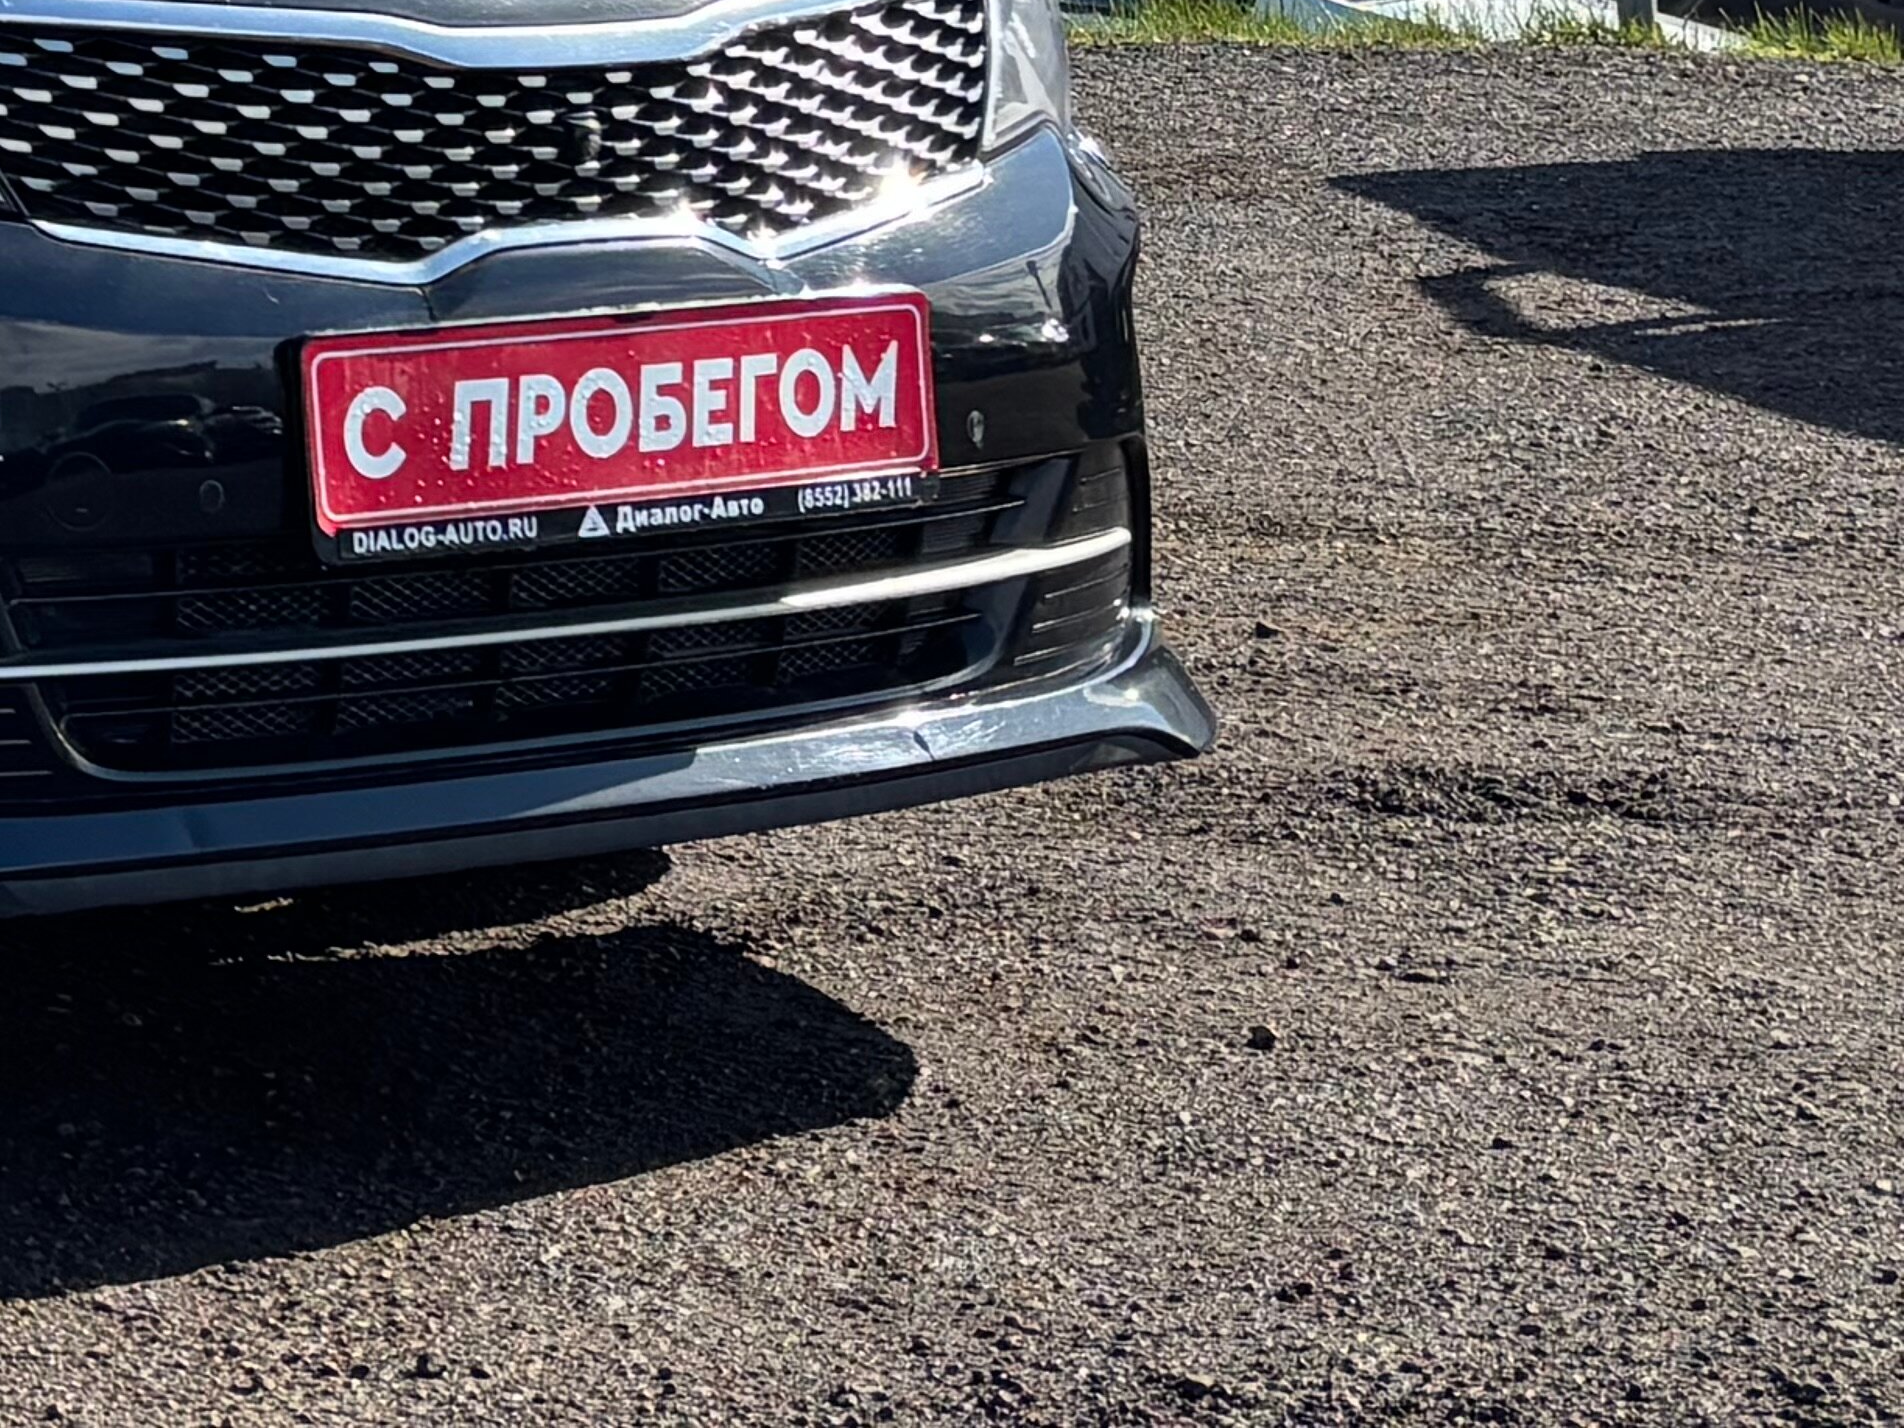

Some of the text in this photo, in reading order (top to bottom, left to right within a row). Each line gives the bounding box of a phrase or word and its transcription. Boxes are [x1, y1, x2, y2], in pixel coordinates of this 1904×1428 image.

[342, 338, 899, 479] С ПРОБЕГОМ
[797, 475, 913, 514] (8552) 382-111
[615, 495, 765, 534] Диалог-Авто
[352, 515, 539, 554] DIALOG-AUTO.RU
